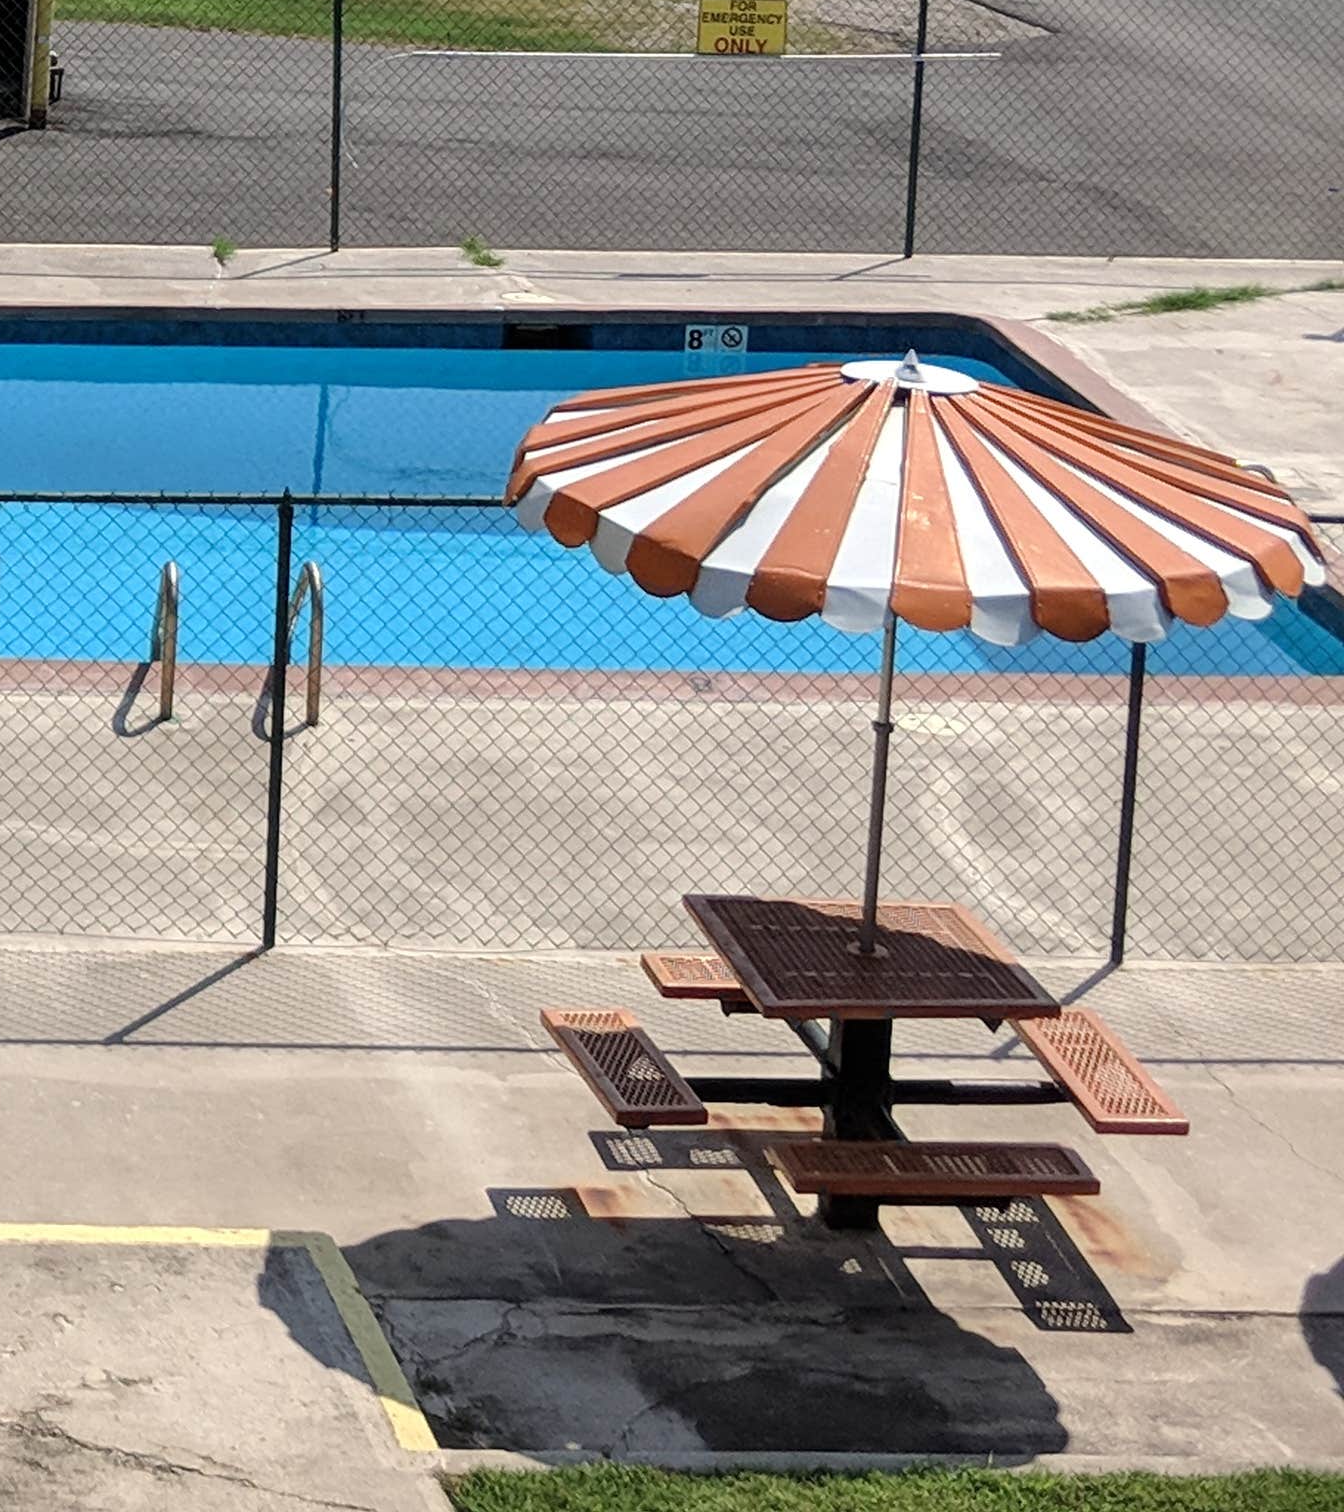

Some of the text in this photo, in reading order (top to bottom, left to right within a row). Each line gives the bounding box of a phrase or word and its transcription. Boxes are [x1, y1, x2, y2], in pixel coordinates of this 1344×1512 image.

[730, 0, 757, 12] FOR
[702, 12, 783, 25] EMERGENCY
[728, 25, 756, 37] USE
[714, 37, 768, 55] ONLY
[688, 329, 704, 350] 8
